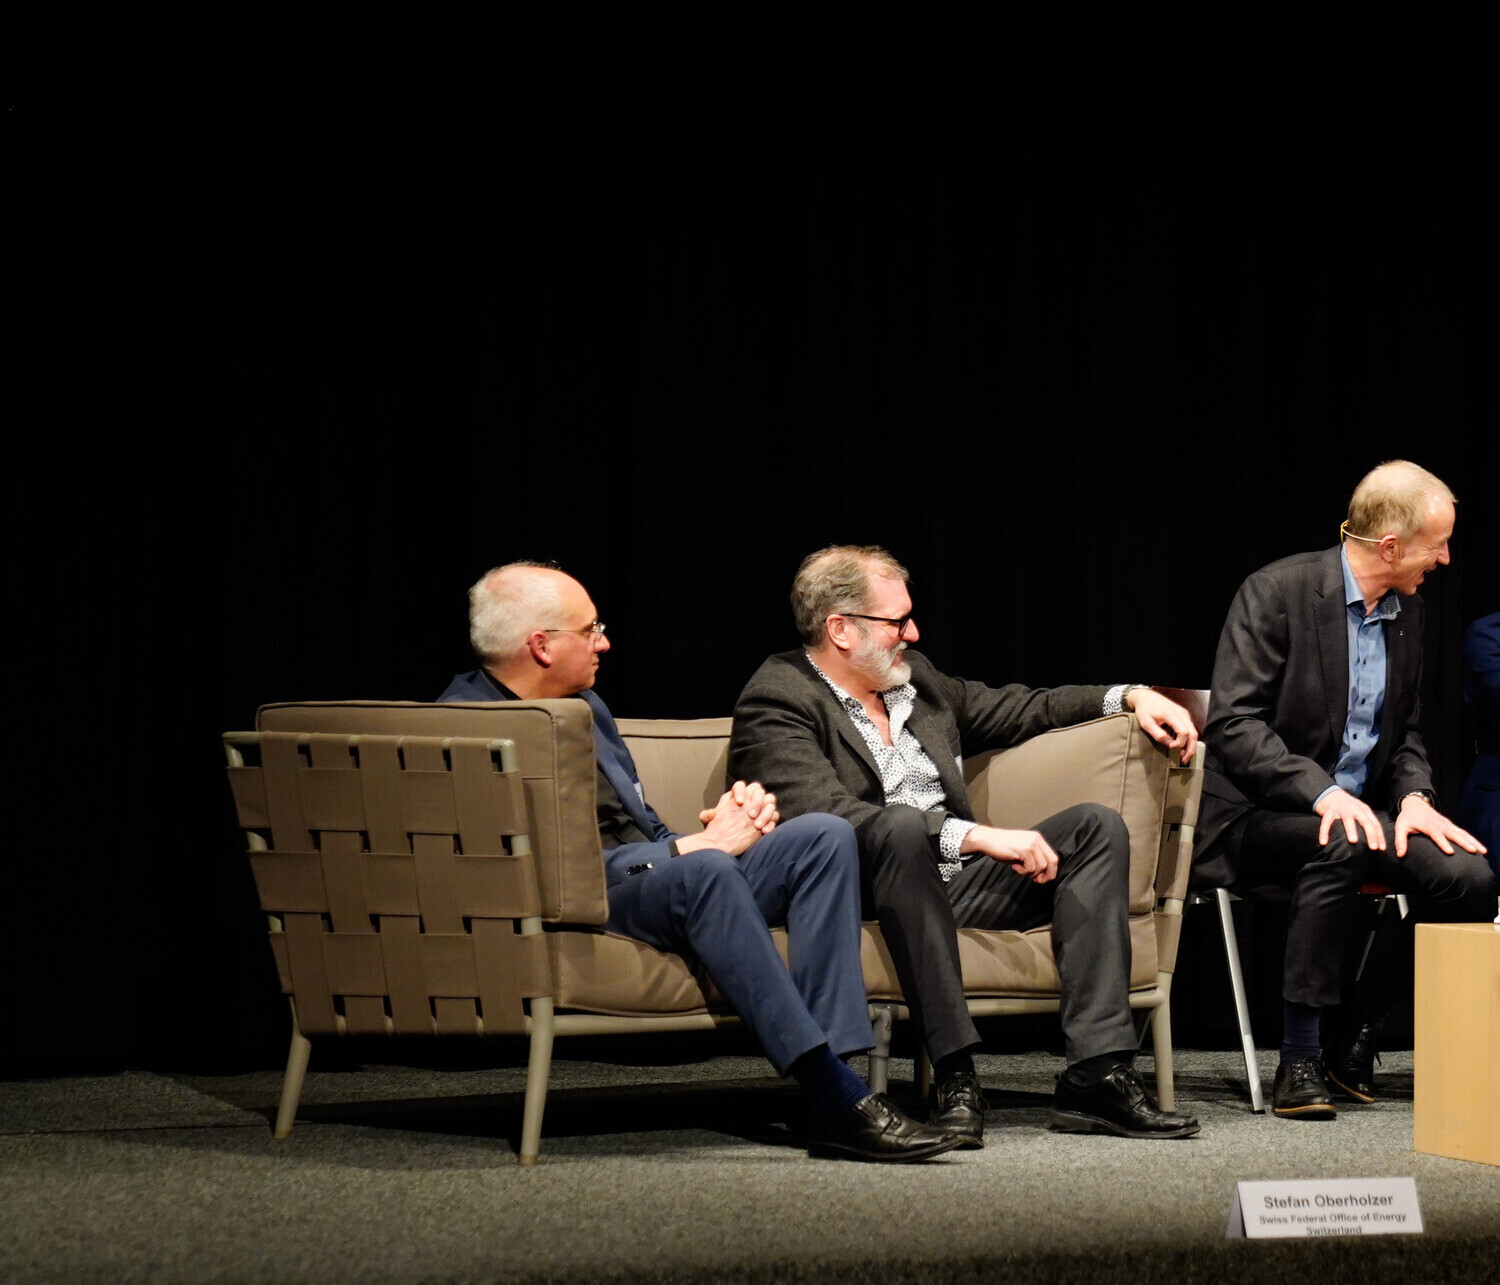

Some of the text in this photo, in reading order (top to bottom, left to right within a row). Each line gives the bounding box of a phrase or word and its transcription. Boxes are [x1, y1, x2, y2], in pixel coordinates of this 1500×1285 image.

[1264, 1194, 1393, 1209] Stefan Oberholzer
[1259, 1213, 1406, 1225] Swiss Federal Office of Energy
[1306, 1226, 1363, 1236] Switzerland
